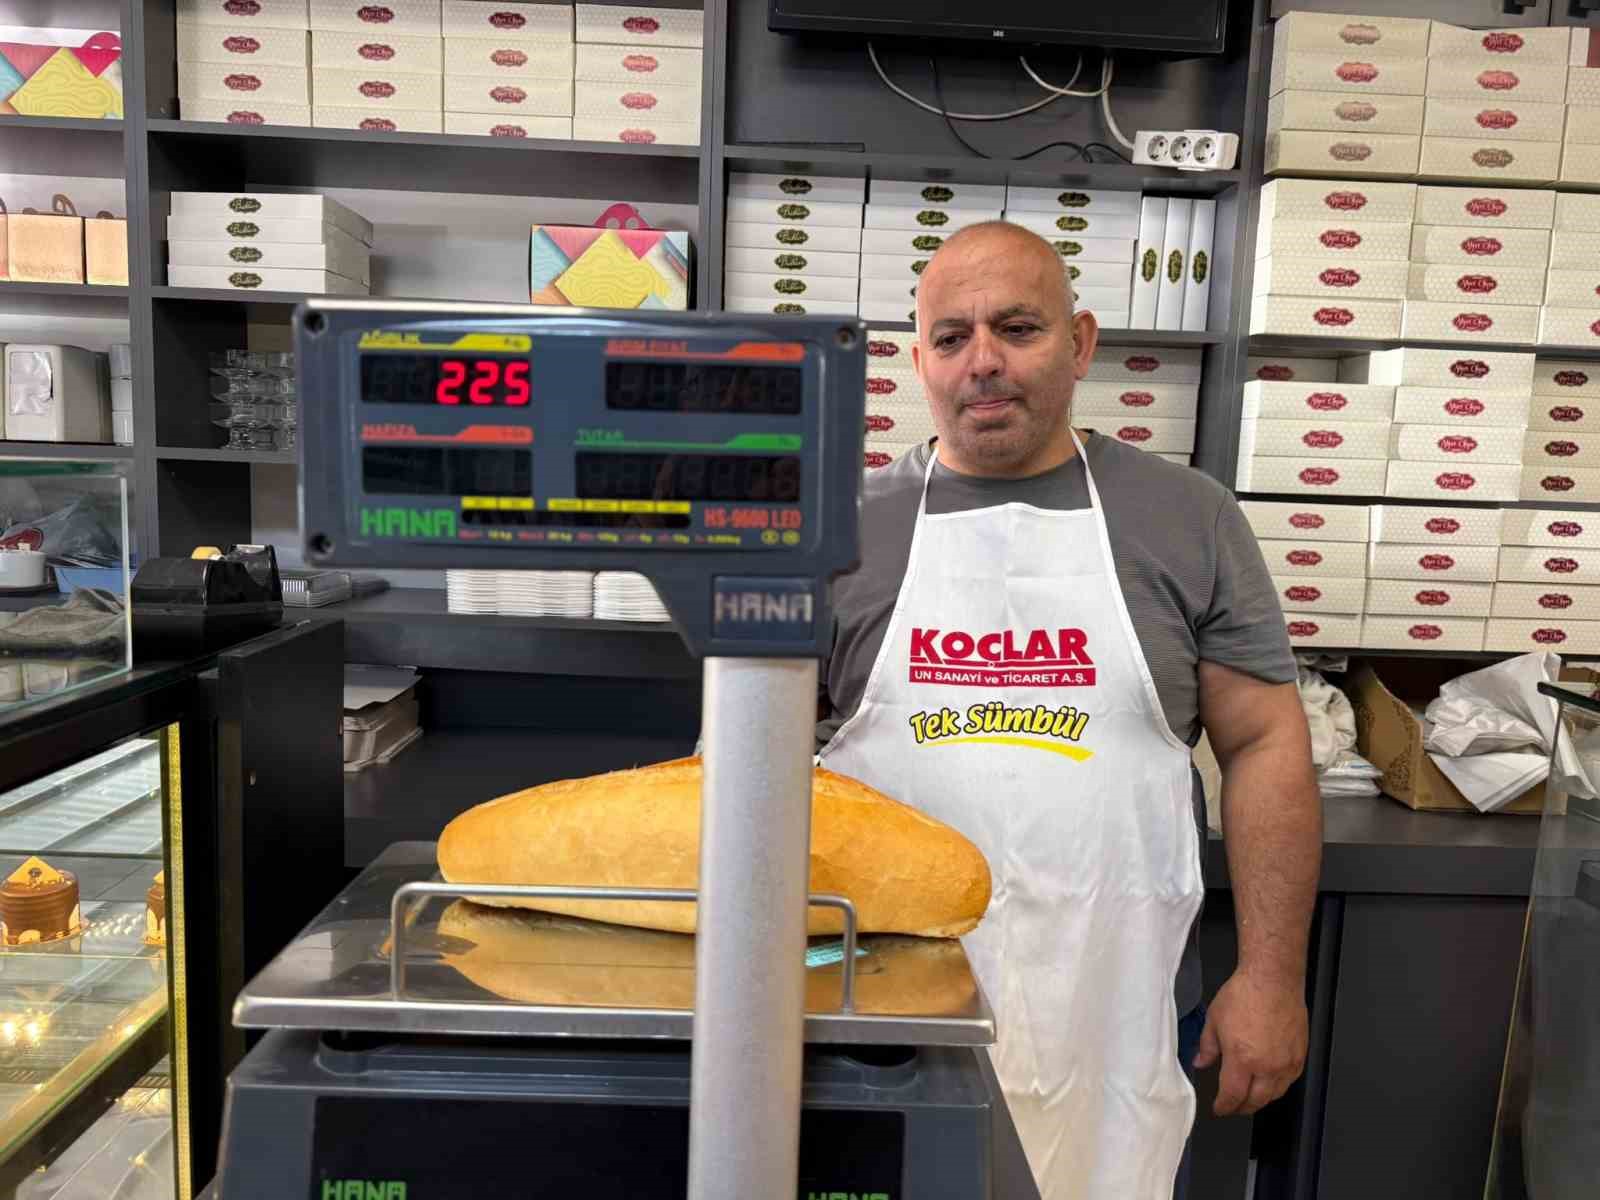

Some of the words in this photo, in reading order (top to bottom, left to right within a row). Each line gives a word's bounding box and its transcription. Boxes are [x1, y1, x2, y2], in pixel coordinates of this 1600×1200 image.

[436, 361, 531, 406] 225
[361, 508, 456, 537] HANA
[714, 592, 814, 623] HANA
[914, 670, 932, 680] UN
[934, 670, 982, 683] SANAYİ
[983, 675, 1000, 684] ve
[1001, 671, 1059, 684] TİCARET
[909, 707, 960, 743] Tek
[963, 702, 1090, 741] Sümbül
